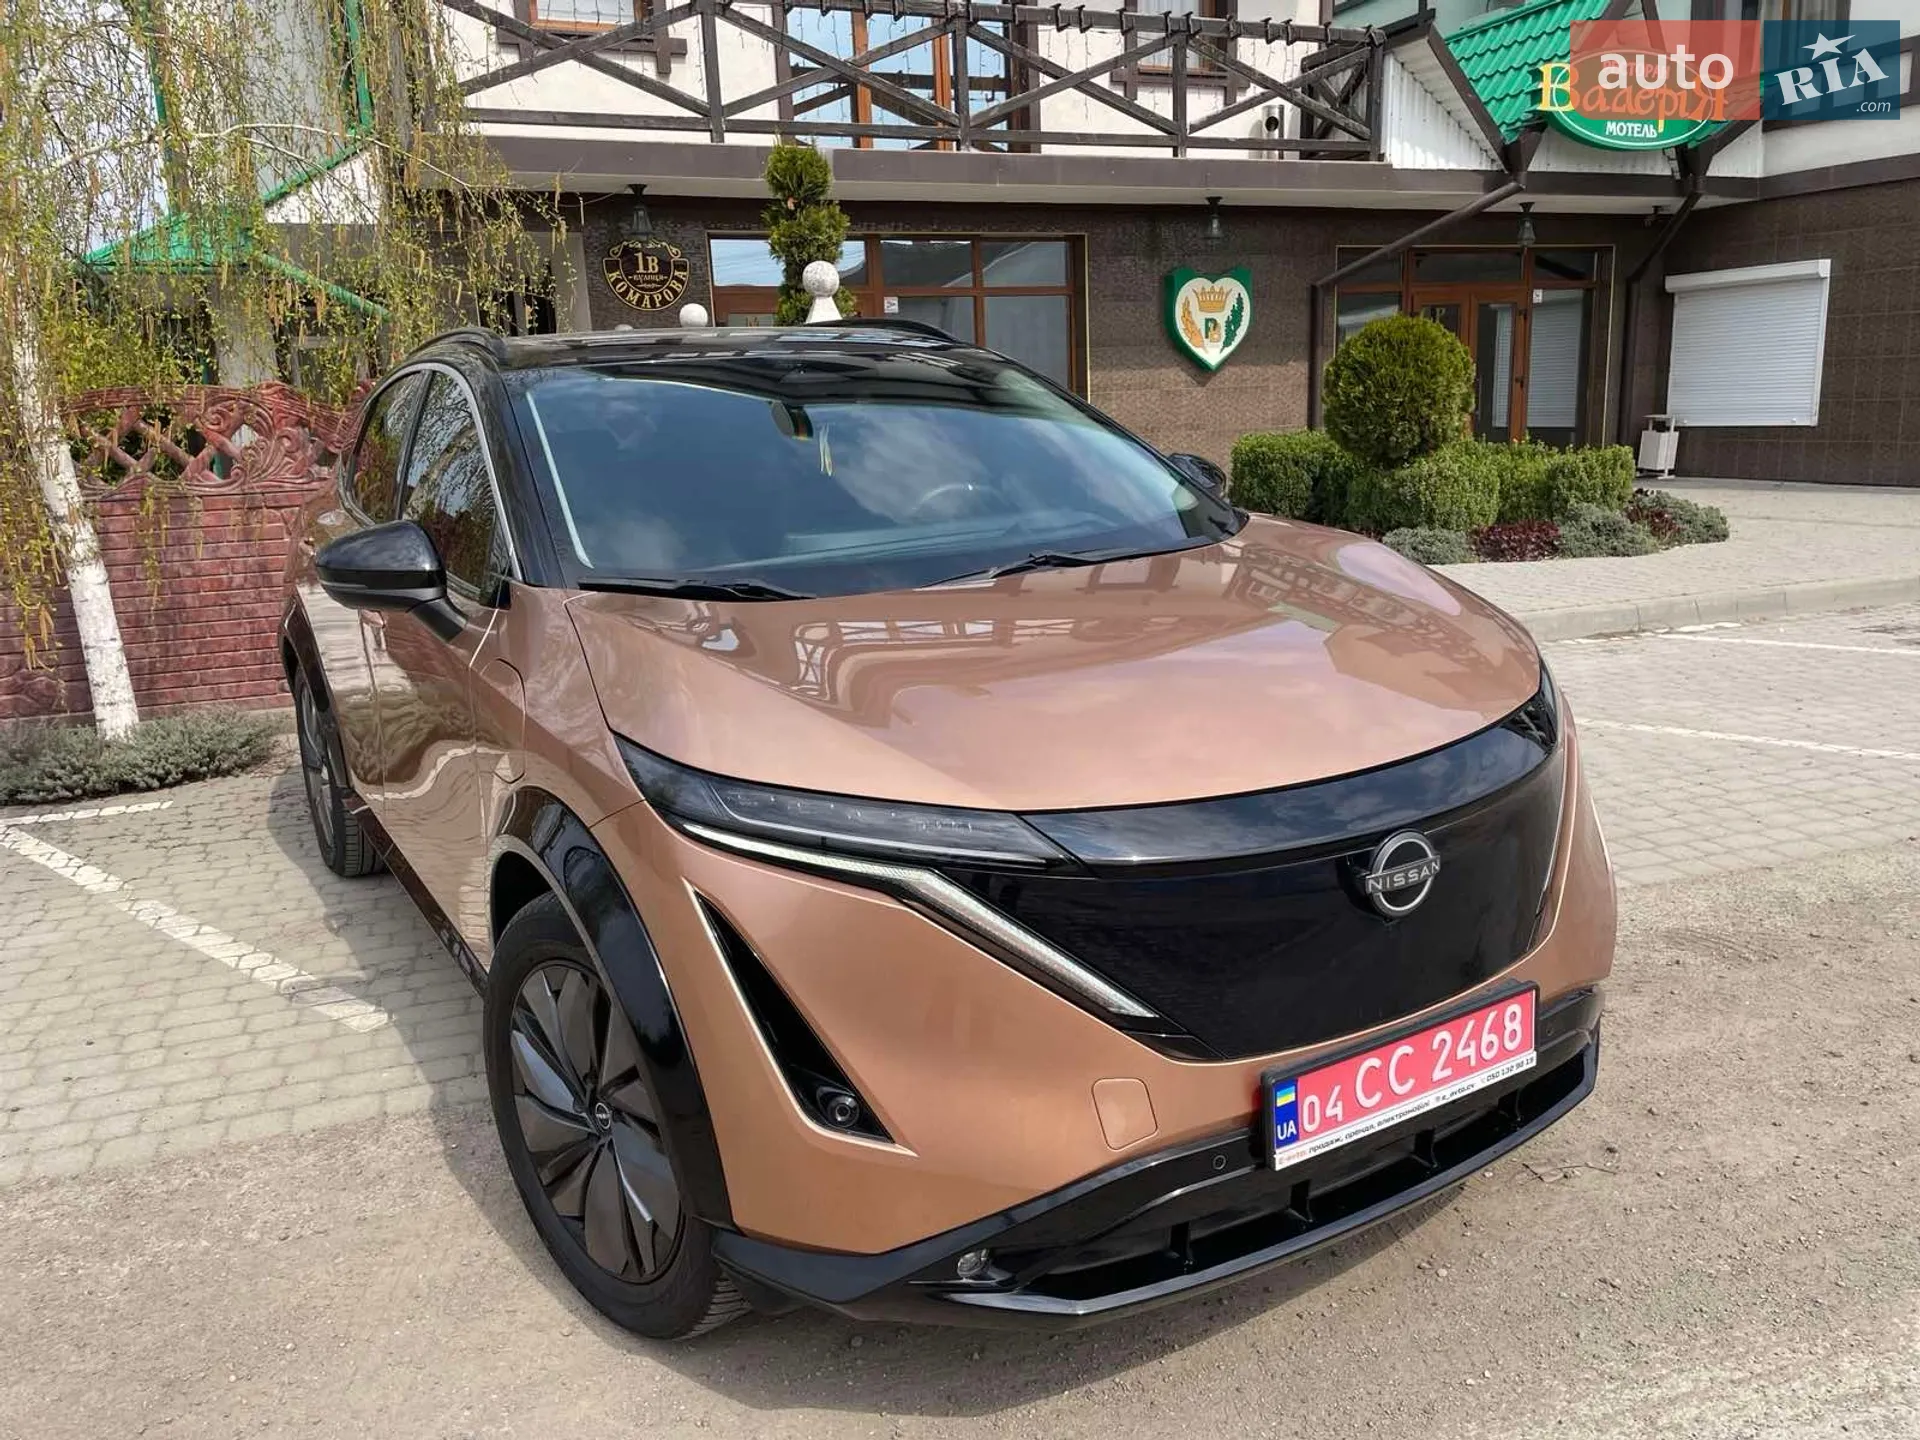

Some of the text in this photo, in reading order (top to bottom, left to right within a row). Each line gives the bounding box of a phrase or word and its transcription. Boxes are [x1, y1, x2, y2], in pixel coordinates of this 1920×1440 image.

[1606, 121, 1658, 138] МОТЕЛЬ
[608, 270, 687, 308] КОМАРОВА
[1368, 859, 1440, 893] NISSAN
[1302, 1003, 1522, 1133] 04 CC 2468
[1277, 1120, 1297, 1140] UA
